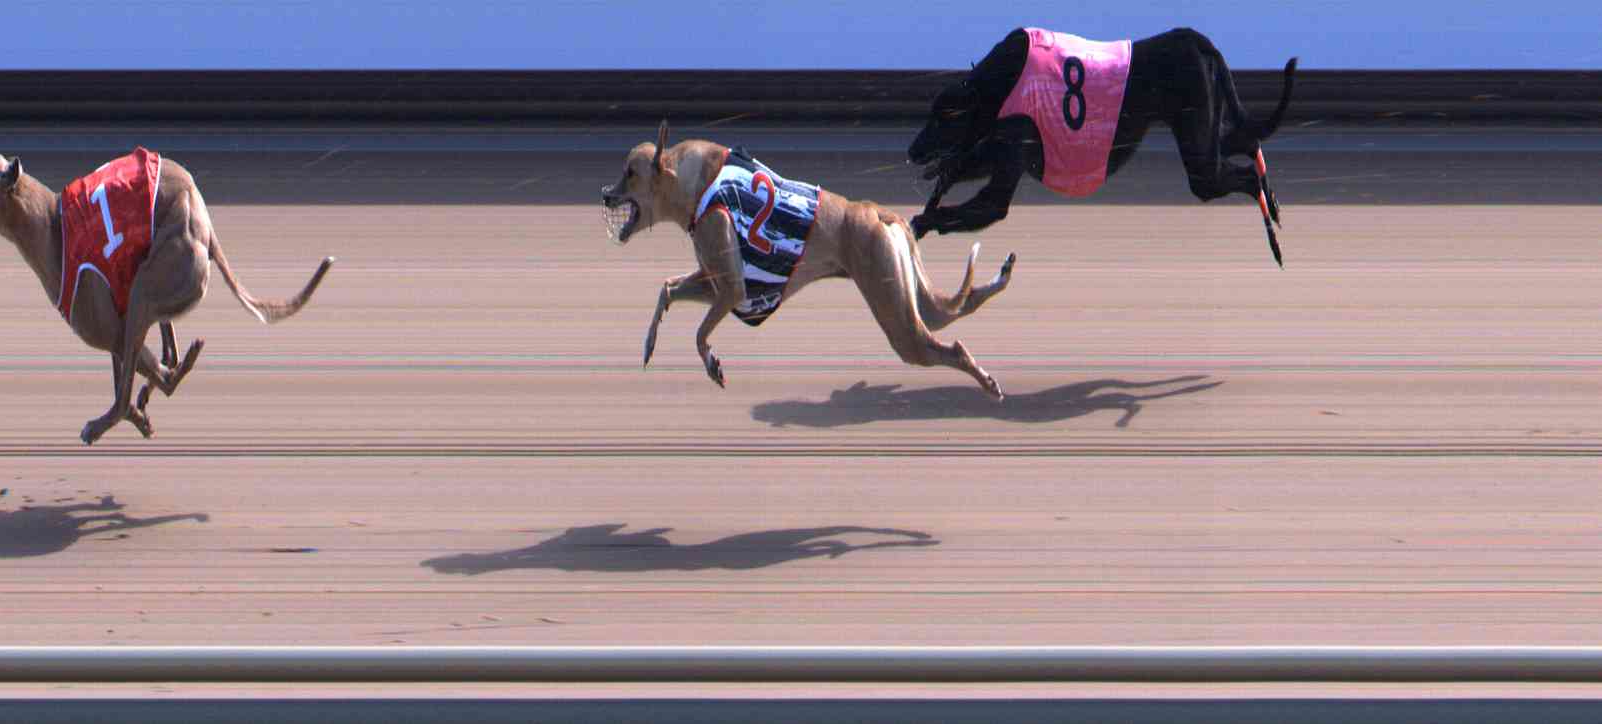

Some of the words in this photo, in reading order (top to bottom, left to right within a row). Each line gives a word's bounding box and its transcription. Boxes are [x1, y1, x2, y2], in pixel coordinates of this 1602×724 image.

[1062, 56, 1087, 131] 8
[91, 183, 124, 259] 1
[749, 171, 775, 255] 2
